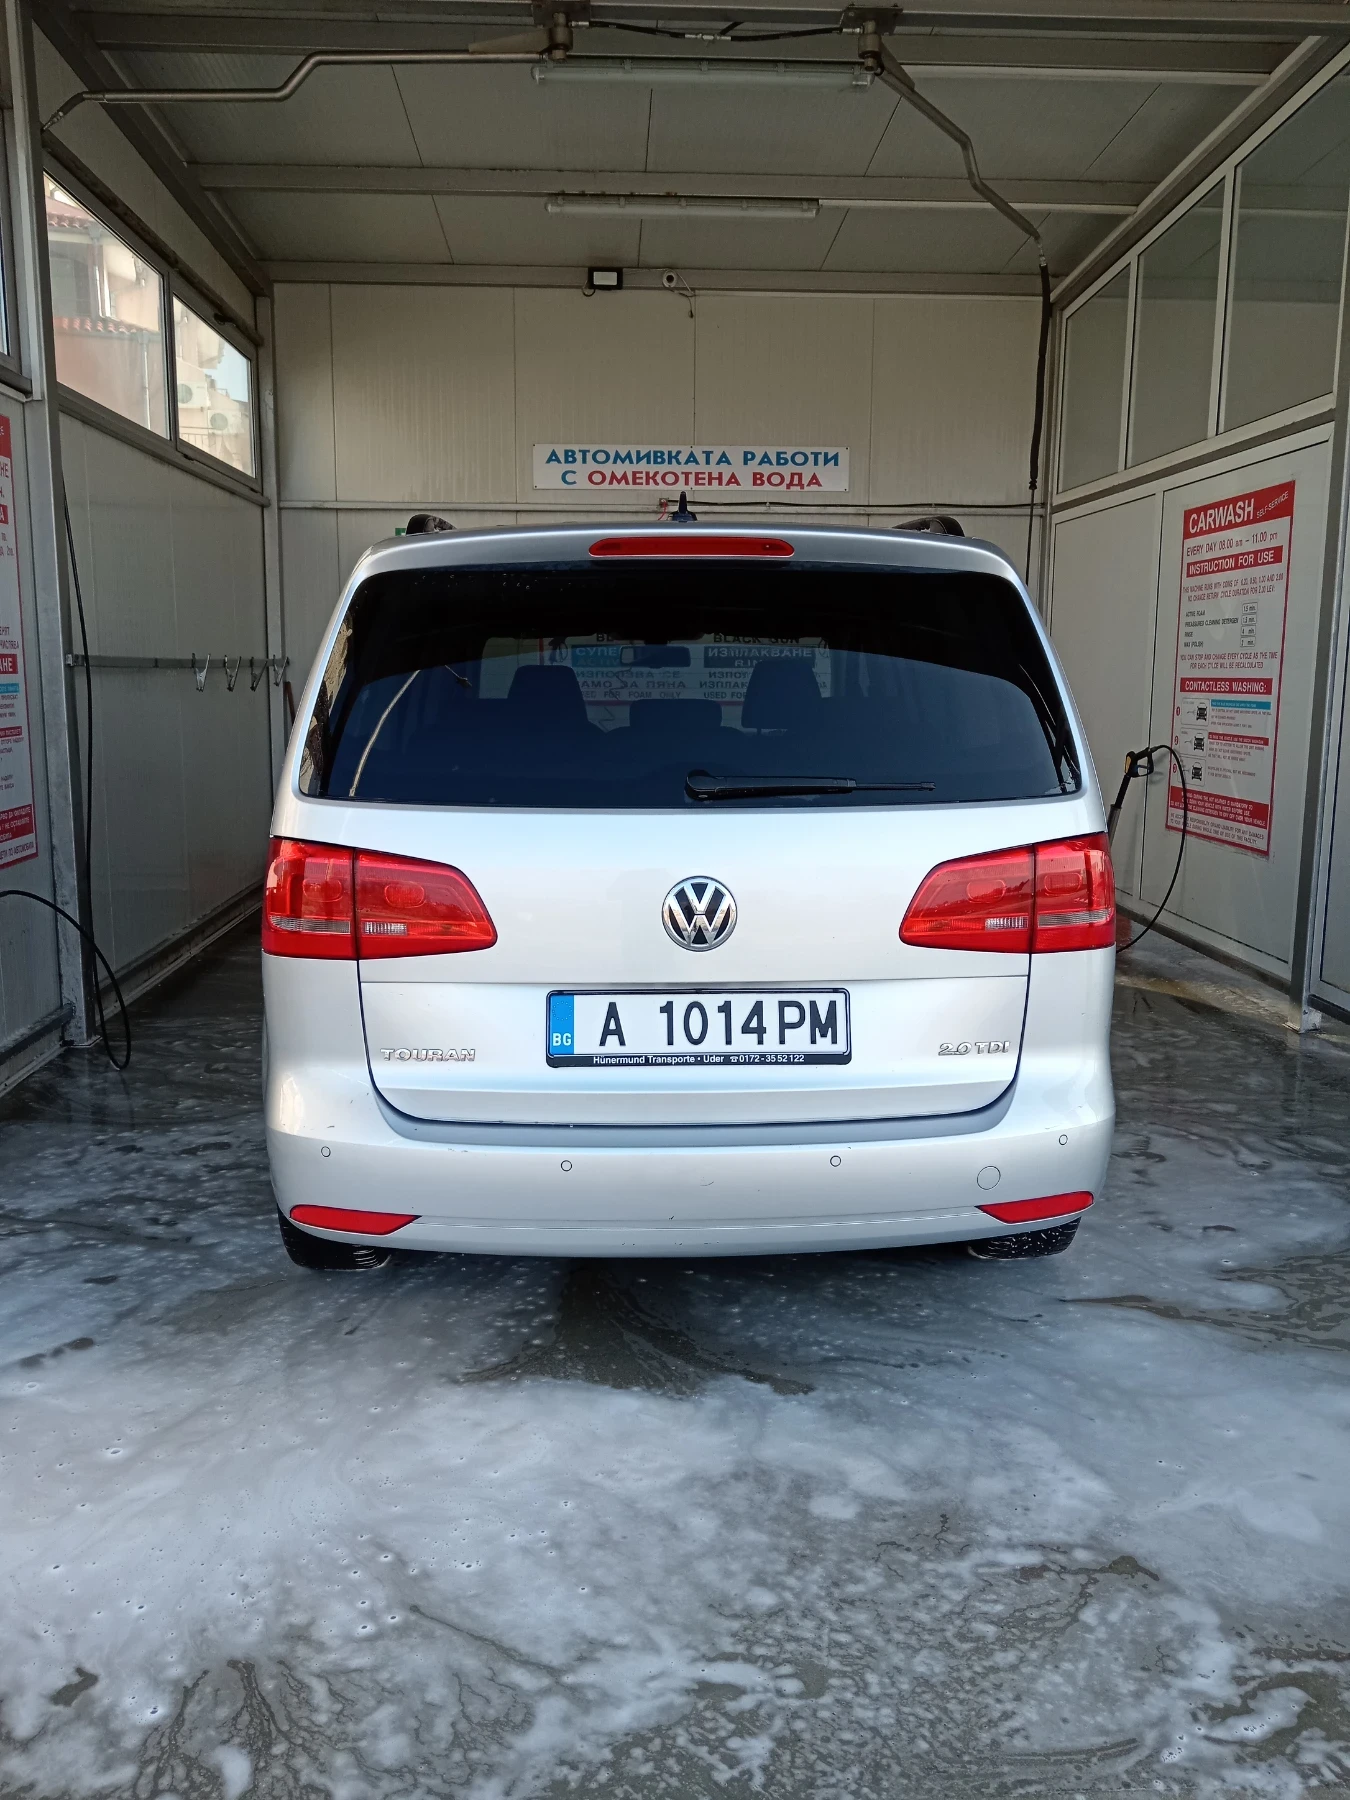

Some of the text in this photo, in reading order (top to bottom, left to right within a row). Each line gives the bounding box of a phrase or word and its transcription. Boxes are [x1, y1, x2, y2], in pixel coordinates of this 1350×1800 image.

[545, 449, 839, 467] АВТОМИВКАТА РАБОТИ
[561, 470, 823, 489] С ОМЕКОТЕНА ВОДА
[1189, 491, 1288, 534] CARWASH SELF-SERVICE
[1187, 544, 1204, 556] EVERY
[1206, 543, 1216, 553] DAY
[1252, 532, 1267, 544] 11.00
[1190, 550, 1274, 575] INSTRUCTION FOR USE
[576, 647, 618, 656] СУПЕ
[1185, 681, 1266, 692] CONTACTLESS WASHING:
[599, 1001, 626, 1046] A
[552, 1033, 571, 1046] BG
[380, 1048, 475, 1062] TOURAN
[593, 1055, 645, 1064] Hünermund
[647, 1055, 695, 1064] Transporte
